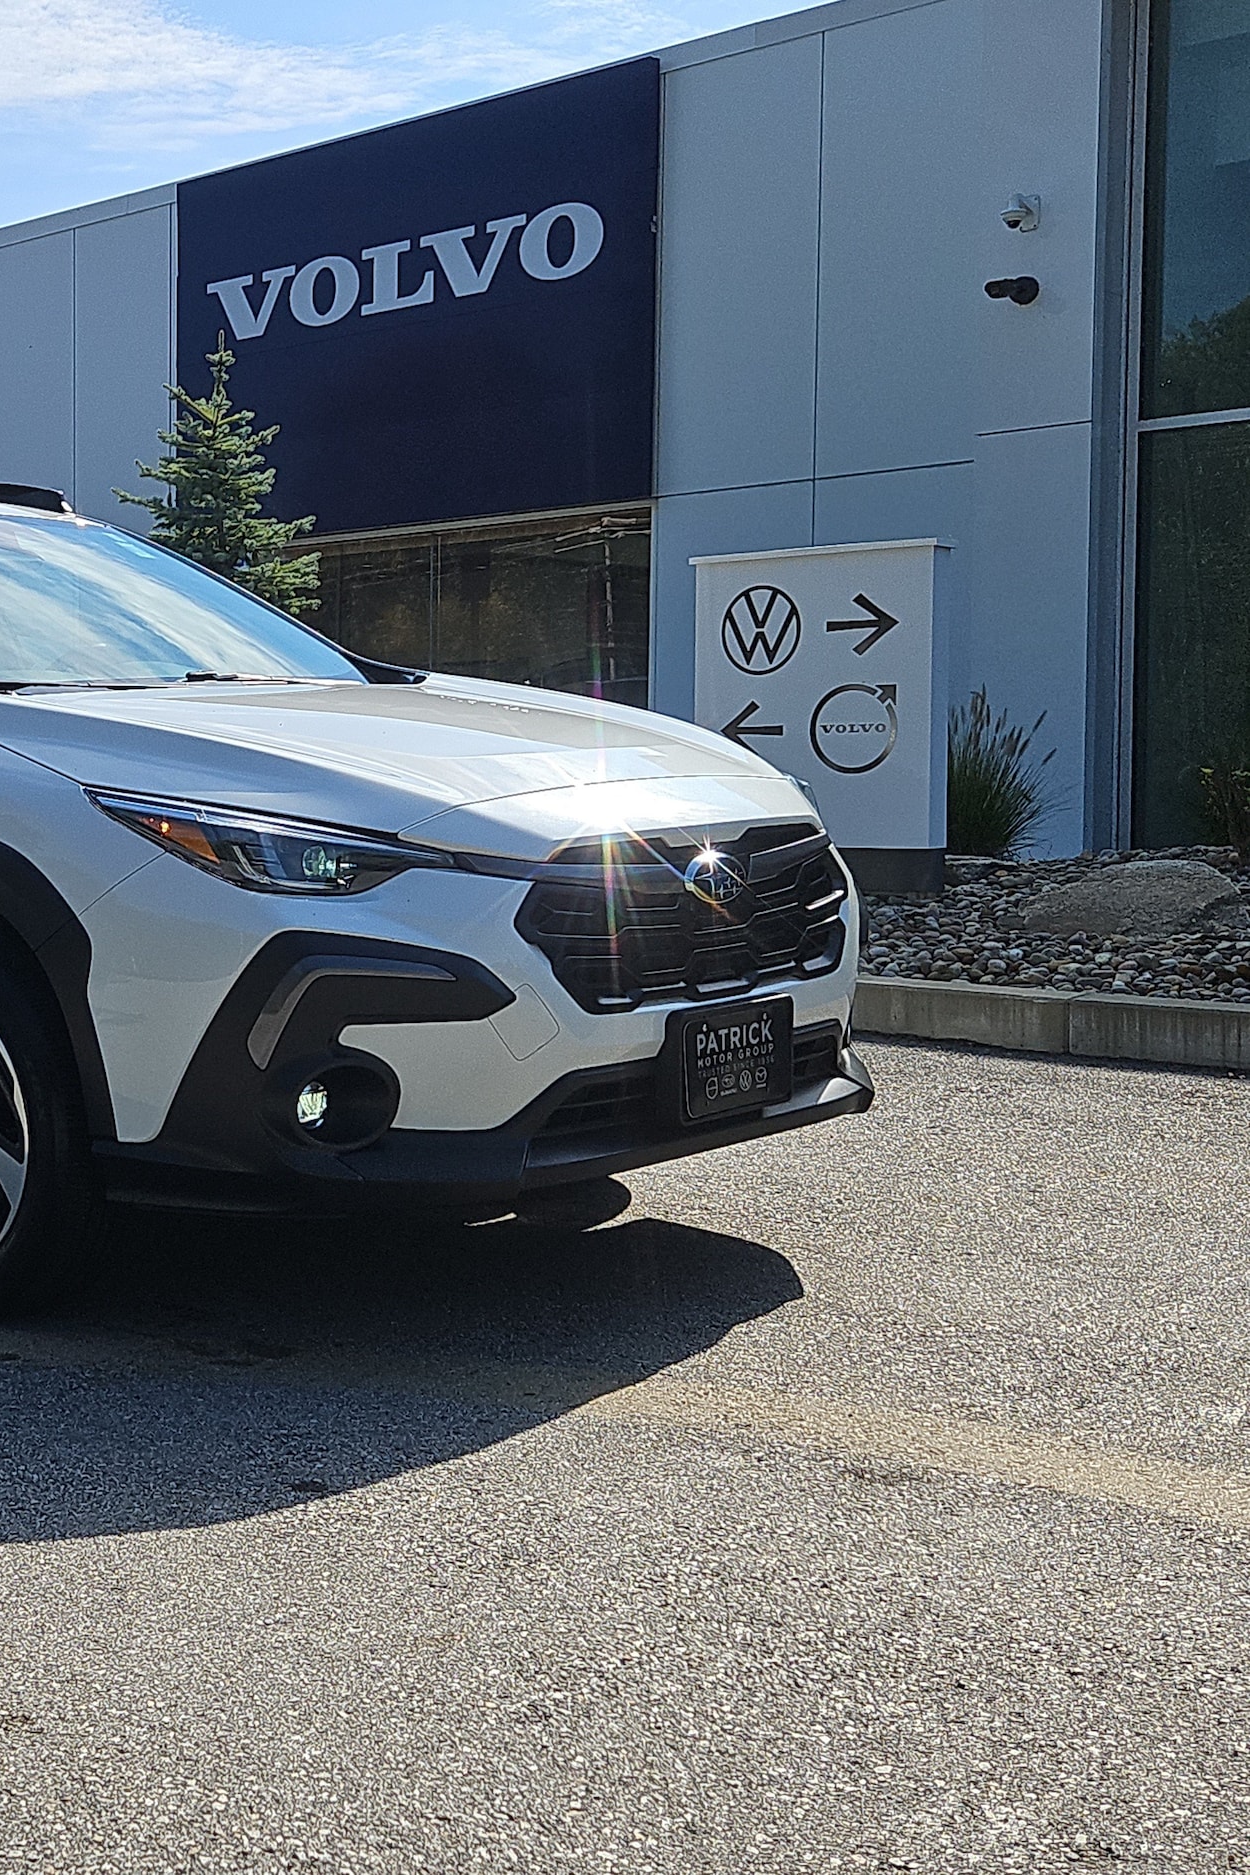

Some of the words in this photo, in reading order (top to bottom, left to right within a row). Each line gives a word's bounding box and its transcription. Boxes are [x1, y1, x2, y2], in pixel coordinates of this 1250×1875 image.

[207, 202, 604, 341] VOLVO
[820, 723, 886, 733] VOLVO
[696, 1019, 773, 1057] PATRICK
[697, 1052, 733, 1069] MOTOR
[738, 1043, 774, 1059] GROUP
